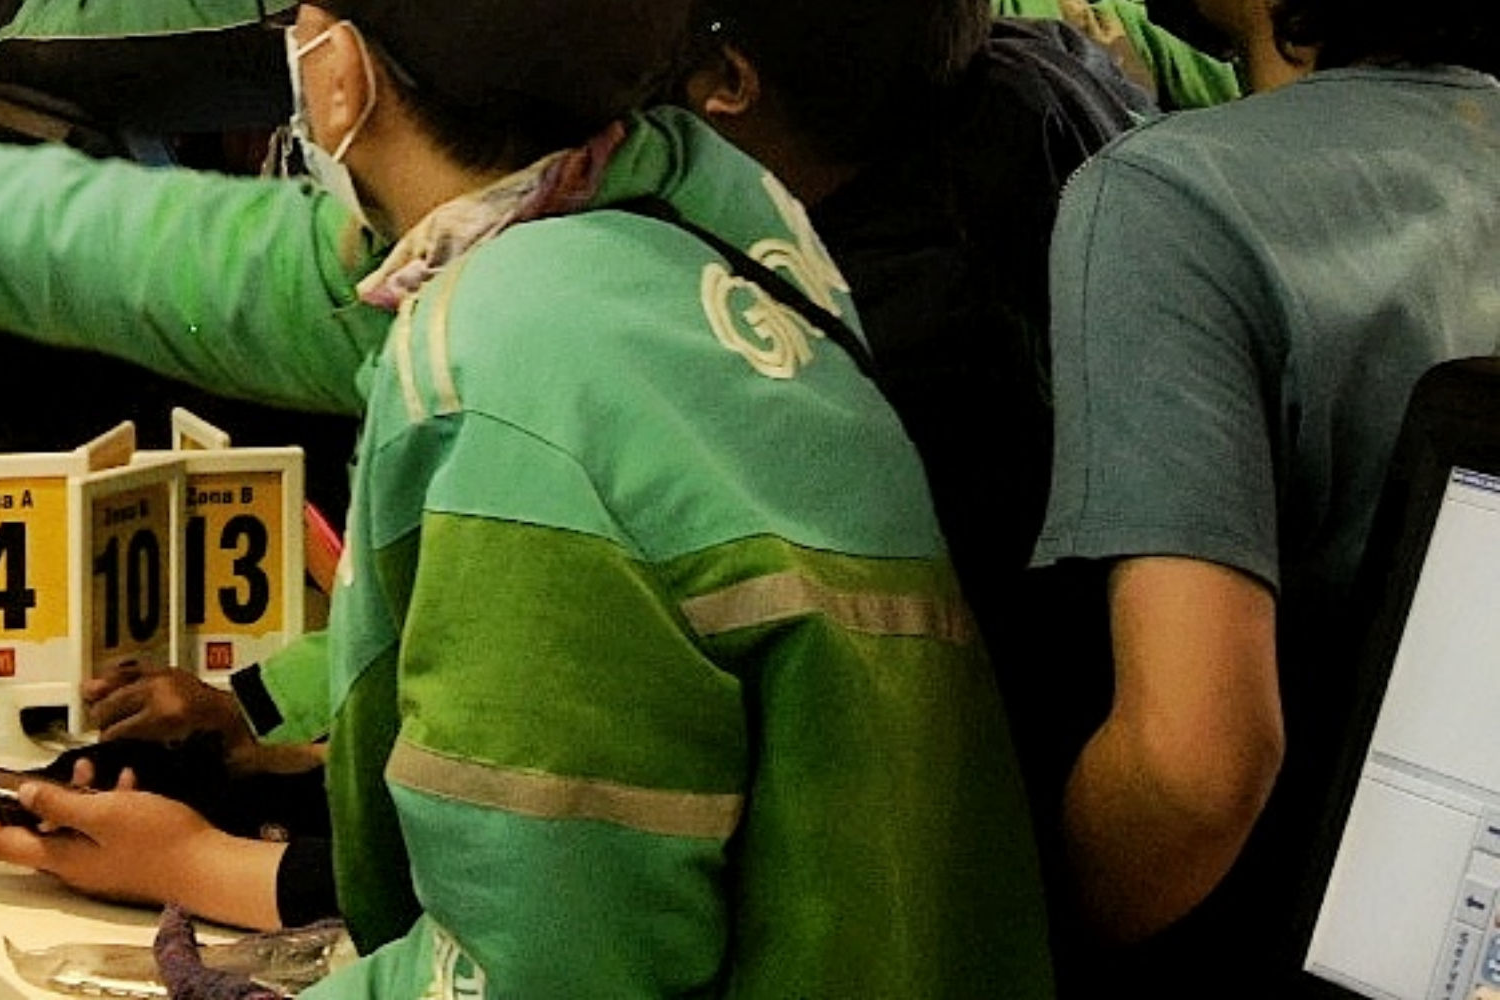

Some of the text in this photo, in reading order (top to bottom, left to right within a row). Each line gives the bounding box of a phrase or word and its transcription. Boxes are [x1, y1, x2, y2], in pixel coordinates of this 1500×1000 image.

[20, 490, 34, 509] A
[186, 487, 253, 508] Zona B
[92, 528, 161, 648] 10
[185, 514, 270, 625] 13
